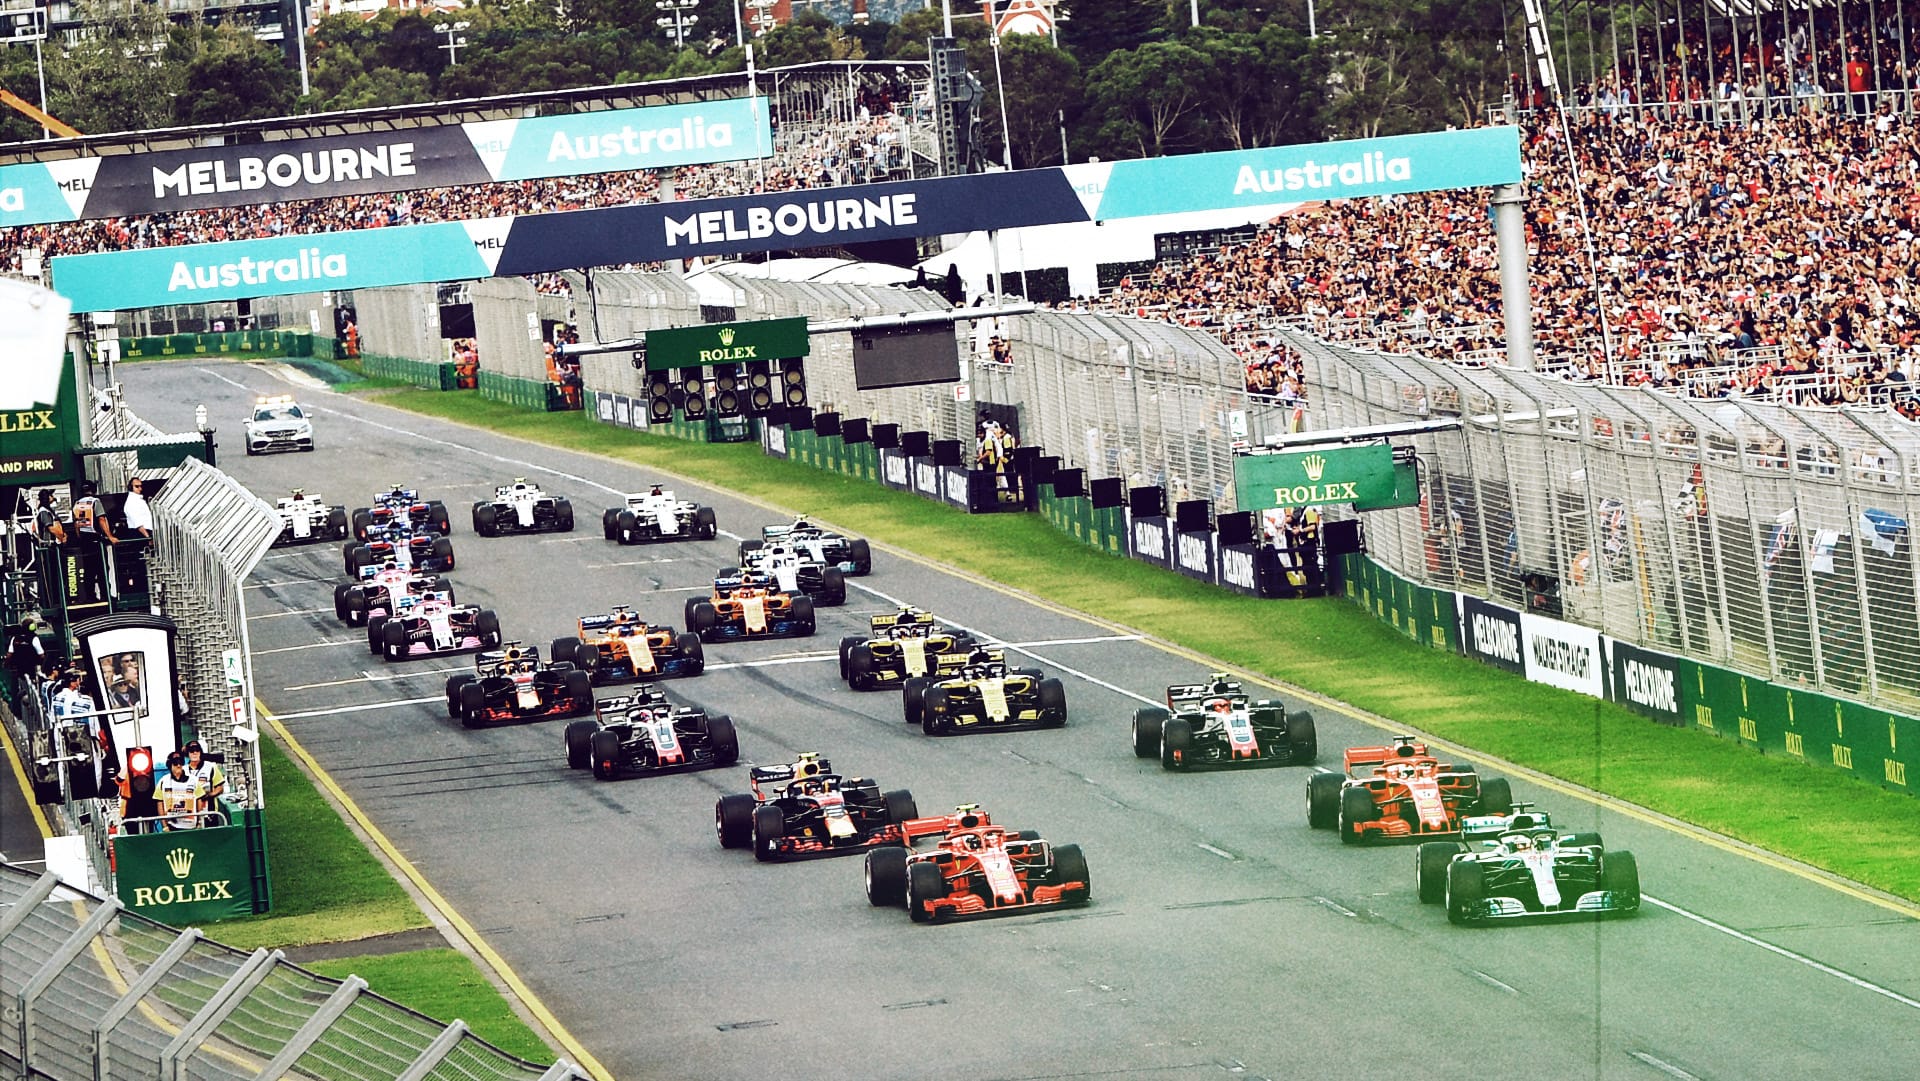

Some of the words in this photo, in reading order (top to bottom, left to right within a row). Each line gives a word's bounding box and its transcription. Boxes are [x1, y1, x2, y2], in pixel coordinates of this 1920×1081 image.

[547, 115, 732, 162] Australia
[152, 142, 416, 198] MELBOURNE
[1233, 151, 1411, 194] Australia
[58, 178, 91, 192] MEL
[664, 194, 918, 246] MELBOURNE
[475, 237, 505, 249] MEL
[167, 248, 347, 291] Australia
[700, 346, 757, 362] ROLEX
[957, 386, 965, 399] F
[0, 410, 56, 432] LEX
[26, 459, 54, 471] PRIX
[1273, 482, 1359, 505] ROLEX
[67, 556, 77, 597] FORMATION
[1472, 612, 1520, 664] MELBOURNE
[1532, 633, 1557, 671] WALKER
[1557, 641, 1591, 681] STRAIGHT
[1623, 657, 1677, 713] MELBOURNE
[232, 698, 241, 722] F
[1831, 743, 1852, 769] ROLEX
[1884, 758, 1906, 786] ROLEX
[133, 880, 232, 907] ROLEX
